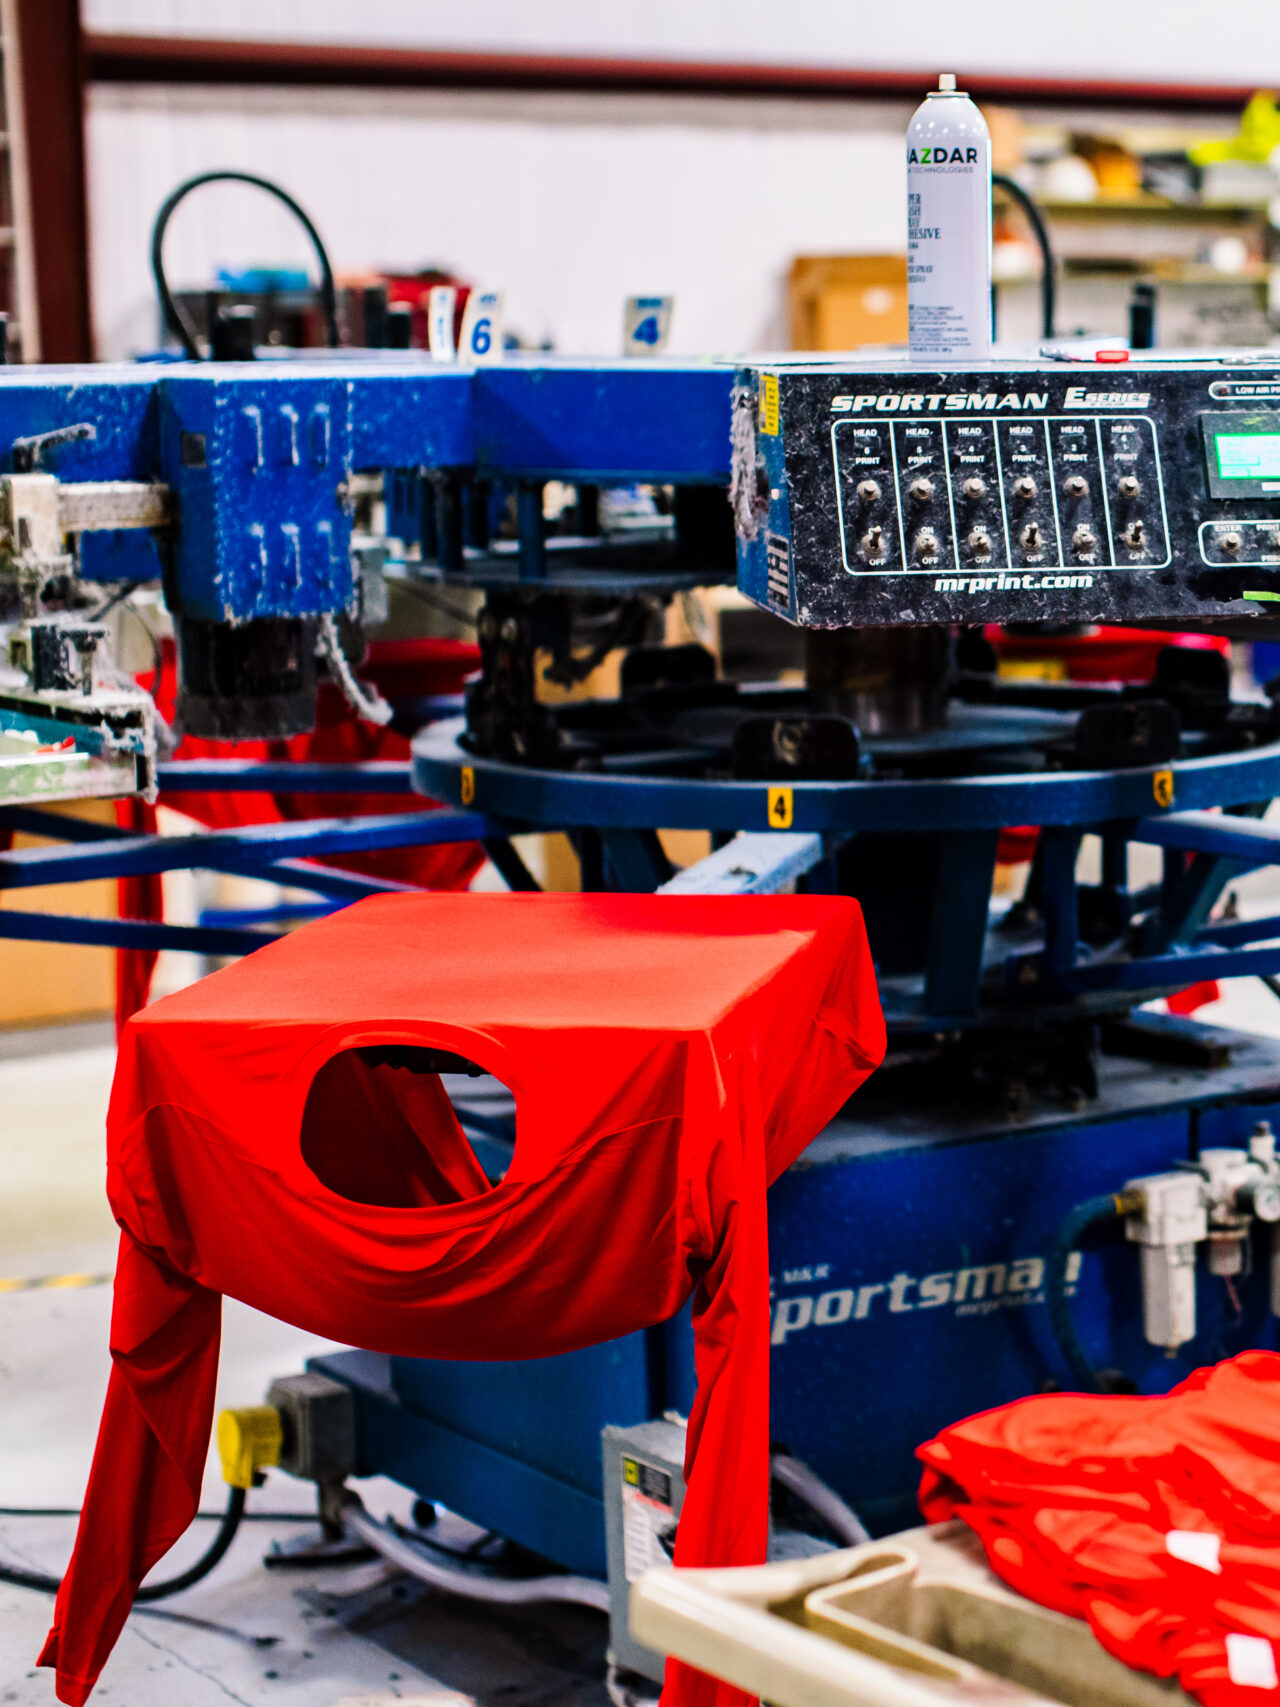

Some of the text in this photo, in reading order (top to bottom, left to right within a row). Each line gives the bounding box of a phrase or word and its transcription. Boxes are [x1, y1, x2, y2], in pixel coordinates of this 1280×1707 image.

[907, 147, 978, 164] AZDAR
[472, 317, 491, 355] 6
[1235, 386, 1255, 395] LOW
[1255, 386, 1270, 394] AIR
[830, 393, 1049, 412] SPORTSMAN
[853, 429, 877, 437] HEAD
[906, 427, 930, 436] HEAD
[958, 427, 982, 435] HEAD
[1009, 426, 1033, 434] HEAD
[1061, 425, 1085, 434] HEAD
[1111, 425, 1135, 433] HEAD
[855, 456, 880, 465] PRINT
[908, 456, 933, 464] PRINT
[960, 455, 985, 463] PRINT
[1012, 454, 1037, 462] PRINT
[1063, 453, 1088, 462] PRINT
[1114, 453, 1138, 461] PRINT
[921, 526, 934, 534] ON
[973, 525, 987, 533] ON
[1214, 524, 1242, 532] ENTER
[1256, 523, 1280, 531] PRINT
[1026, 554, 1044, 562] OFF
[1129, 552, 1146, 560] OFF
[869, 558, 886, 566] OFF
[922, 557, 939, 565] OFF
[934, 574, 1093, 595] mrprint.com
[774, 795, 787, 821] 4
[769, 1251, 1083, 1346] portsma
